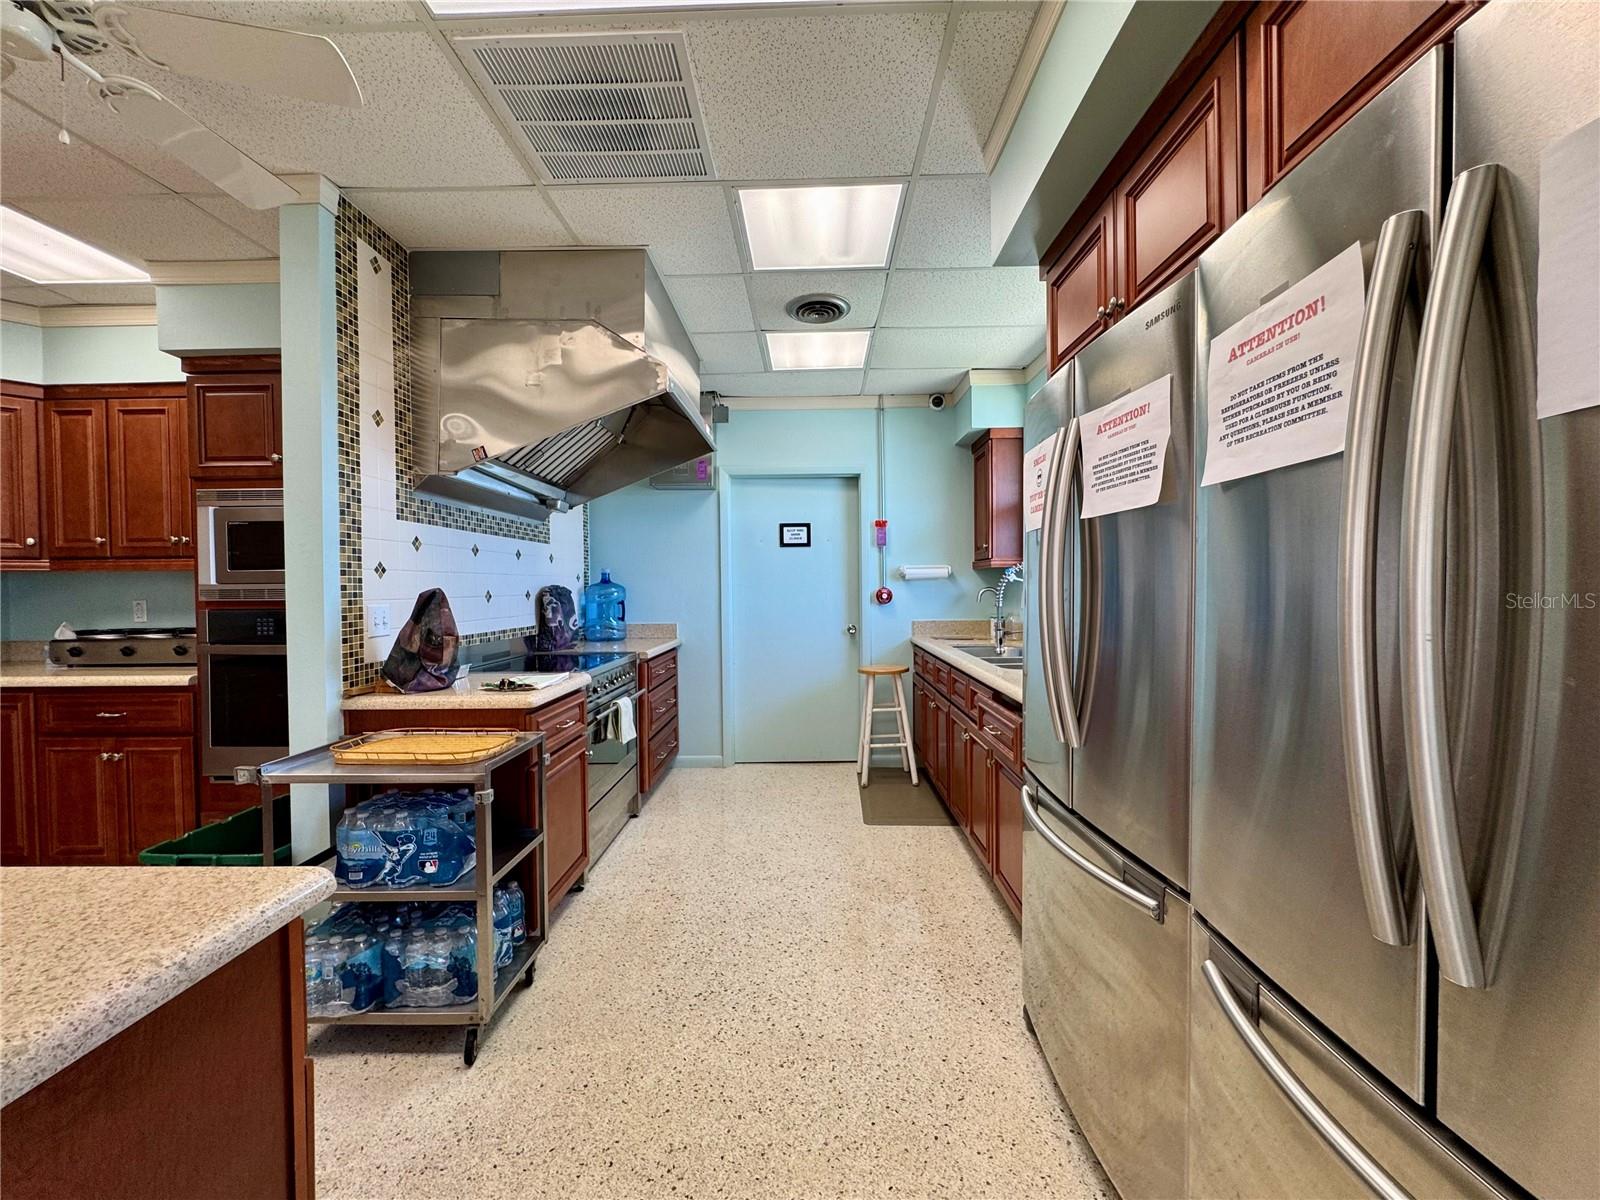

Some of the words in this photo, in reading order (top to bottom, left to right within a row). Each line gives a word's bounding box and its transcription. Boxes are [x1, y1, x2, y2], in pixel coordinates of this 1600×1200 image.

[1145, 301, 1182, 330] SAMSUNG
[1228, 296, 1326, 363] ATTENTION!
[1230, 394, 1237, 402] DO
[1237, 388, 1249, 399] NOT
[1249, 381, 1265, 392] TAKE
[1265, 371, 1286, 385] ITEMS
[1287, 361, 1307, 376] FROM
[1308, 353, 1324, 366] THE
[1246, 347, 1275, 366] CAMERAS
[1276, 342, 1284, 350] IN
[1221, 390, 1264, 415] REFRIGERATORS
[1264, 386, 1273, 395] OR
[1273, 371, 1308, 392] FREEZERS
[1309, 357, 1340, 376] UNLESS
[1222, 411, 1241, 423] EITHER
[1242, 395, 1276, 415] PURCHASED
[1276, 391, 1285, 400] BY
[1286, 385, 1301, 397] YOU
[1301, 381, 1311, 390] OR
[1312, 370, 1338, 386] BEING
[1225, 420, 1238, 431] USED
[1239, 416, 1249, 425] FOR
[1255, 399, 1291, 419] CLUBHOUSE
[1292, 383, 1333, 404] FUNCTION.
[1096, 402, 1151, 435] ATTENTION!
[1219, 433, 1230, 442] ANY
[1262, 411, 1285, 426] PLEASE
[1286, 406, 1300, 417] SEE
[1300, 404, 1306, 412] A
[1307, 390, 1343, 409] MEMBER
[1234, 436, 1245, 445] THE
[1245, 422, 1283, 441] RECREATION
[1283, 407, 1328, 428] COMMITTEE.
